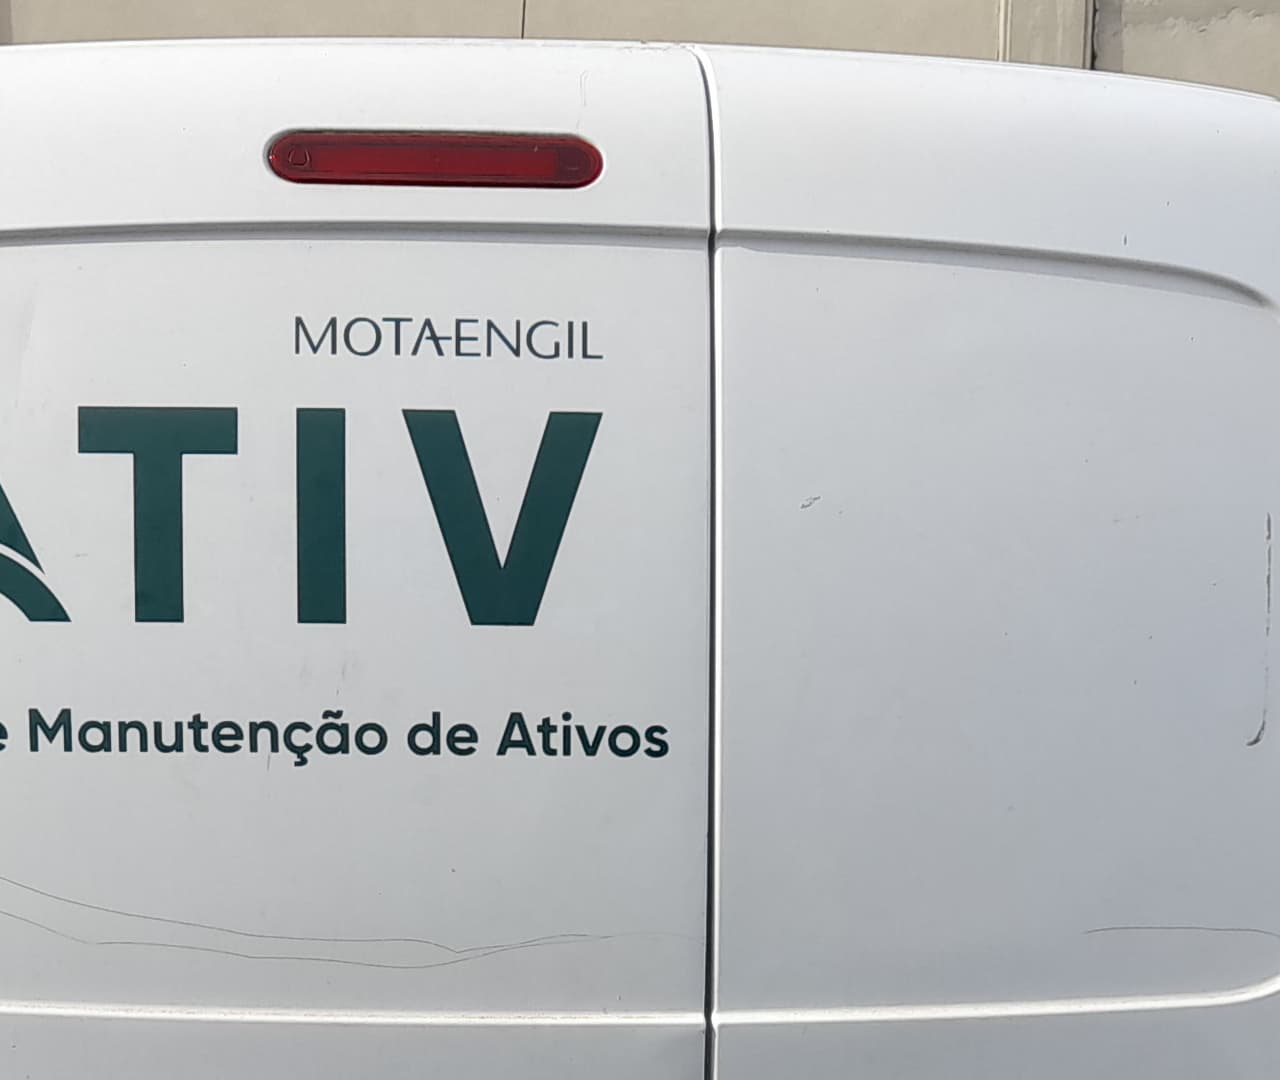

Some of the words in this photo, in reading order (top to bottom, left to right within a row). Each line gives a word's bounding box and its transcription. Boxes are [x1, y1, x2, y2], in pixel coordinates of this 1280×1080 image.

[28, 708, 388, 767] Manutenção
[407, 711, 479, 757] de
[496, 711, 669, 759] Ativos
